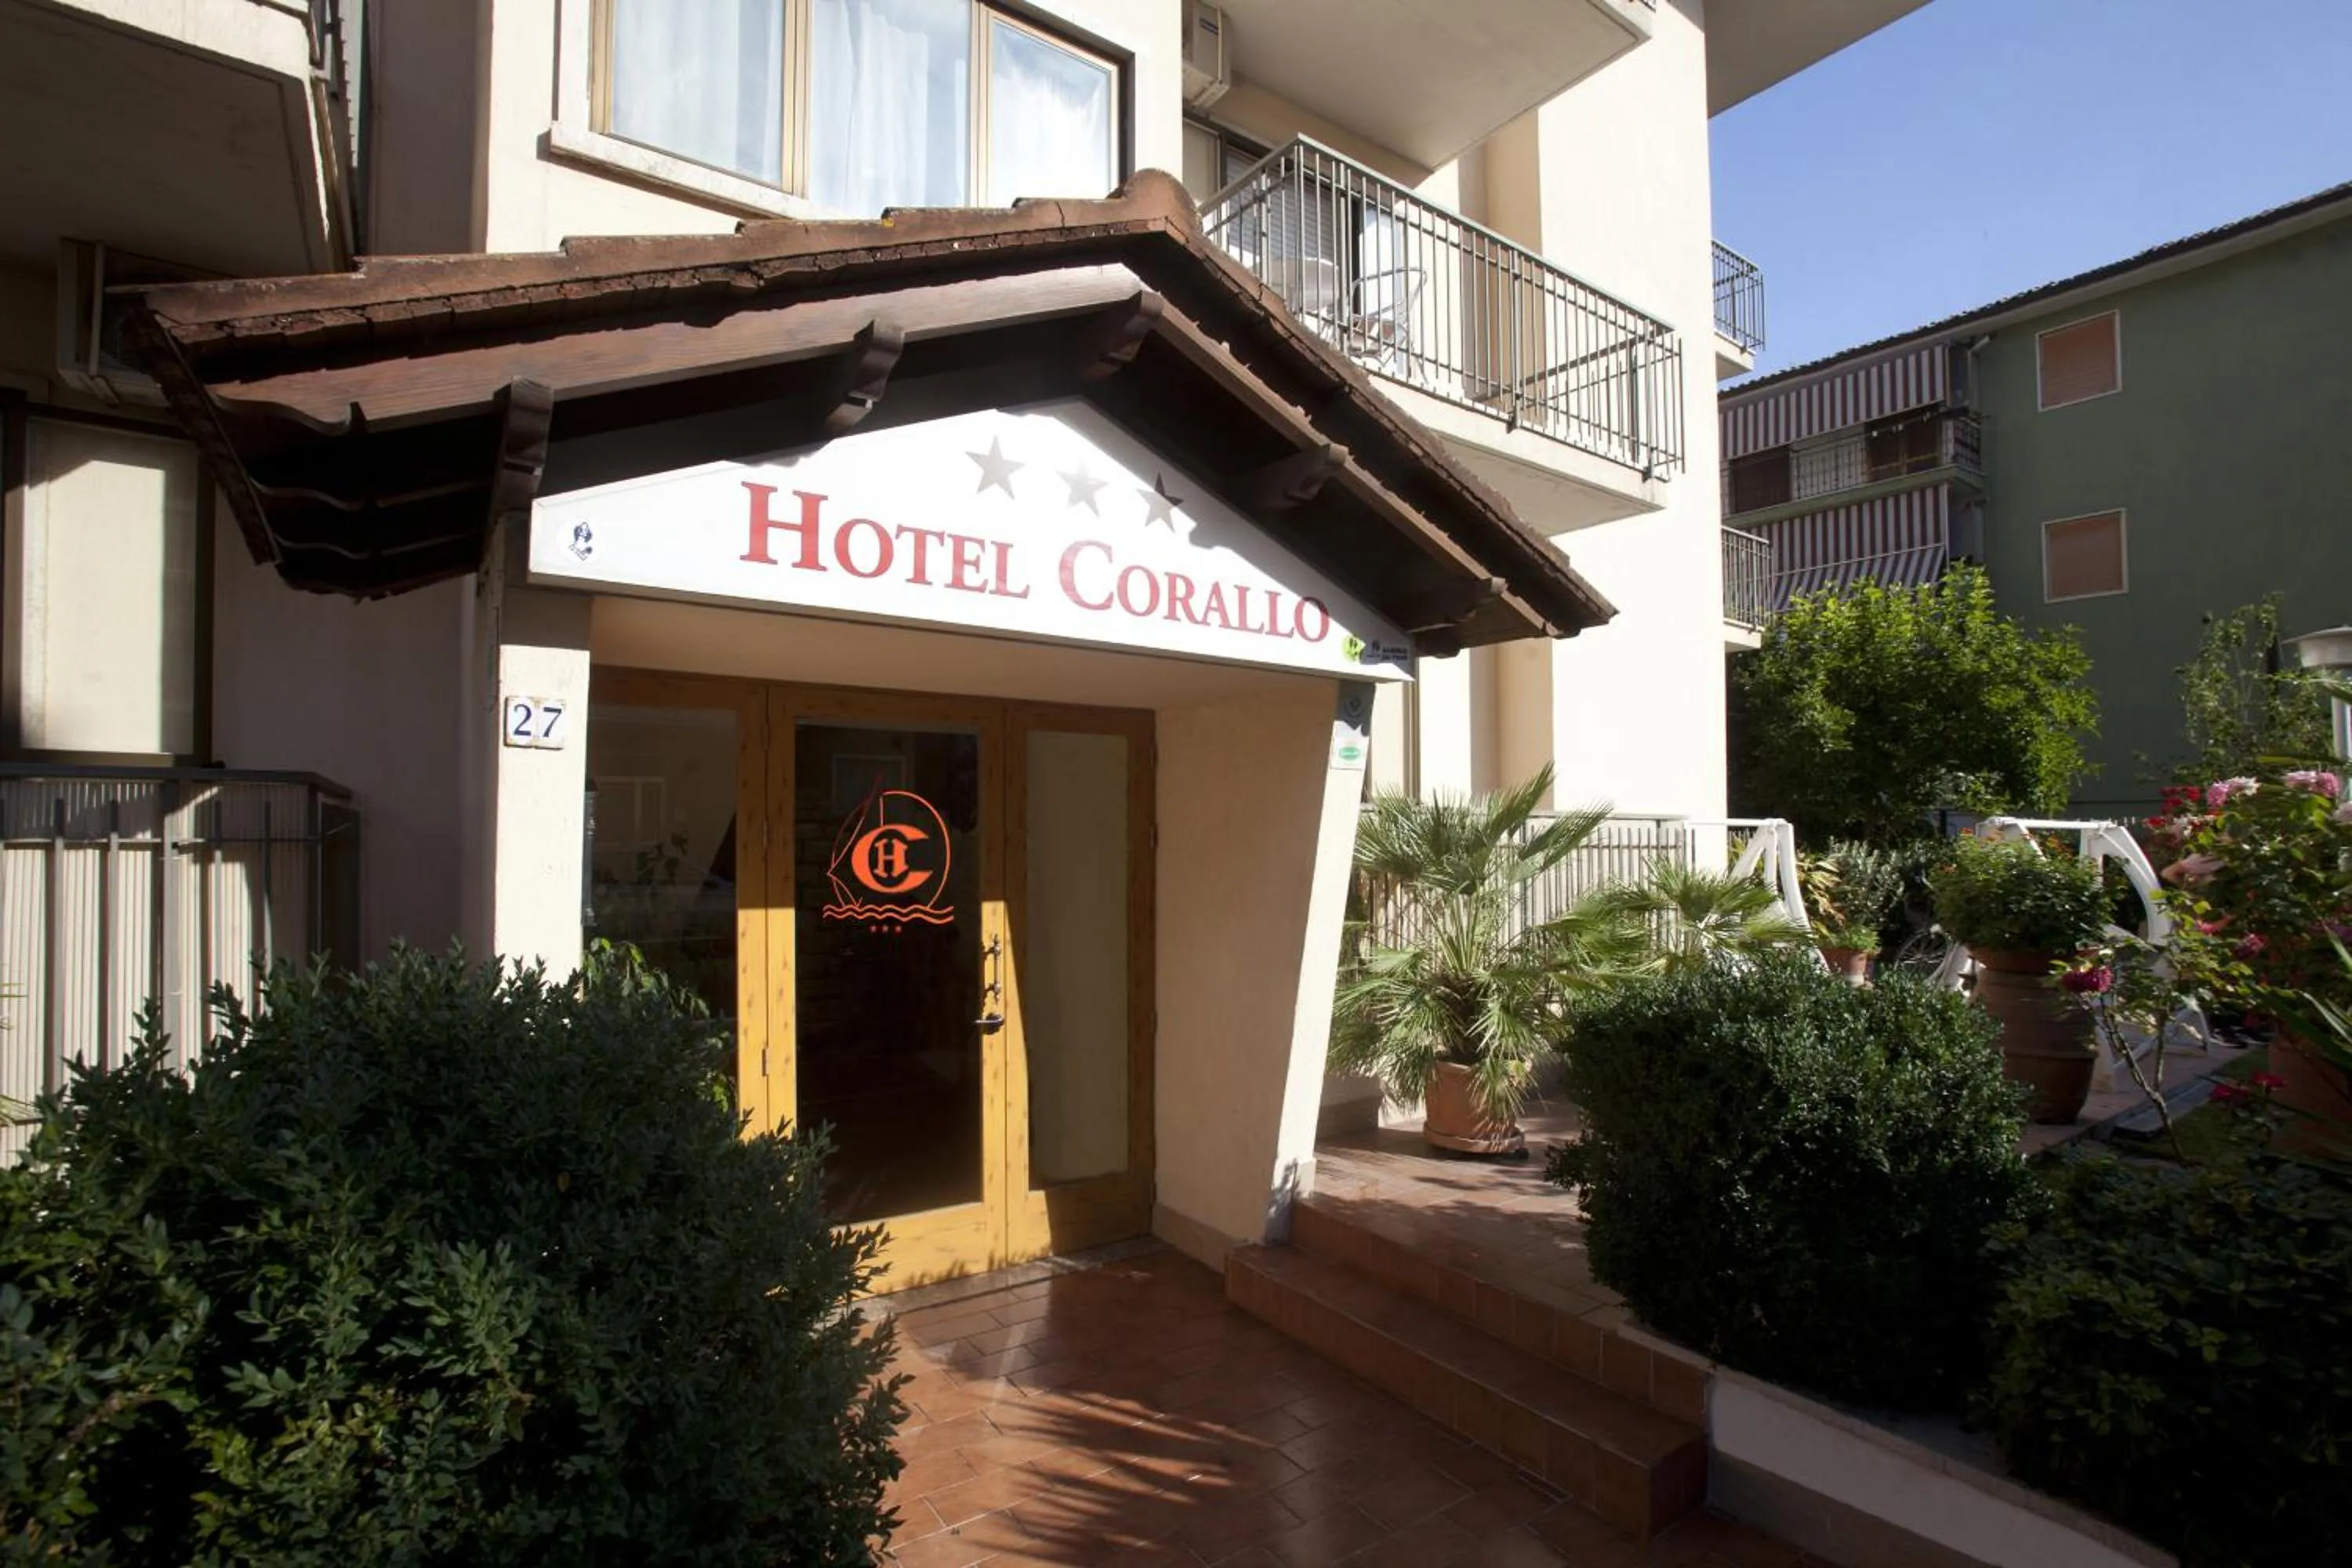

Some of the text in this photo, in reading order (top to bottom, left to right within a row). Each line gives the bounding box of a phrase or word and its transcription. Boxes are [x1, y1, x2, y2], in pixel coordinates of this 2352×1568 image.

[740, 481, 1330, 642] HOTEL CORALLO
[514, 703, 562, 738] 27
